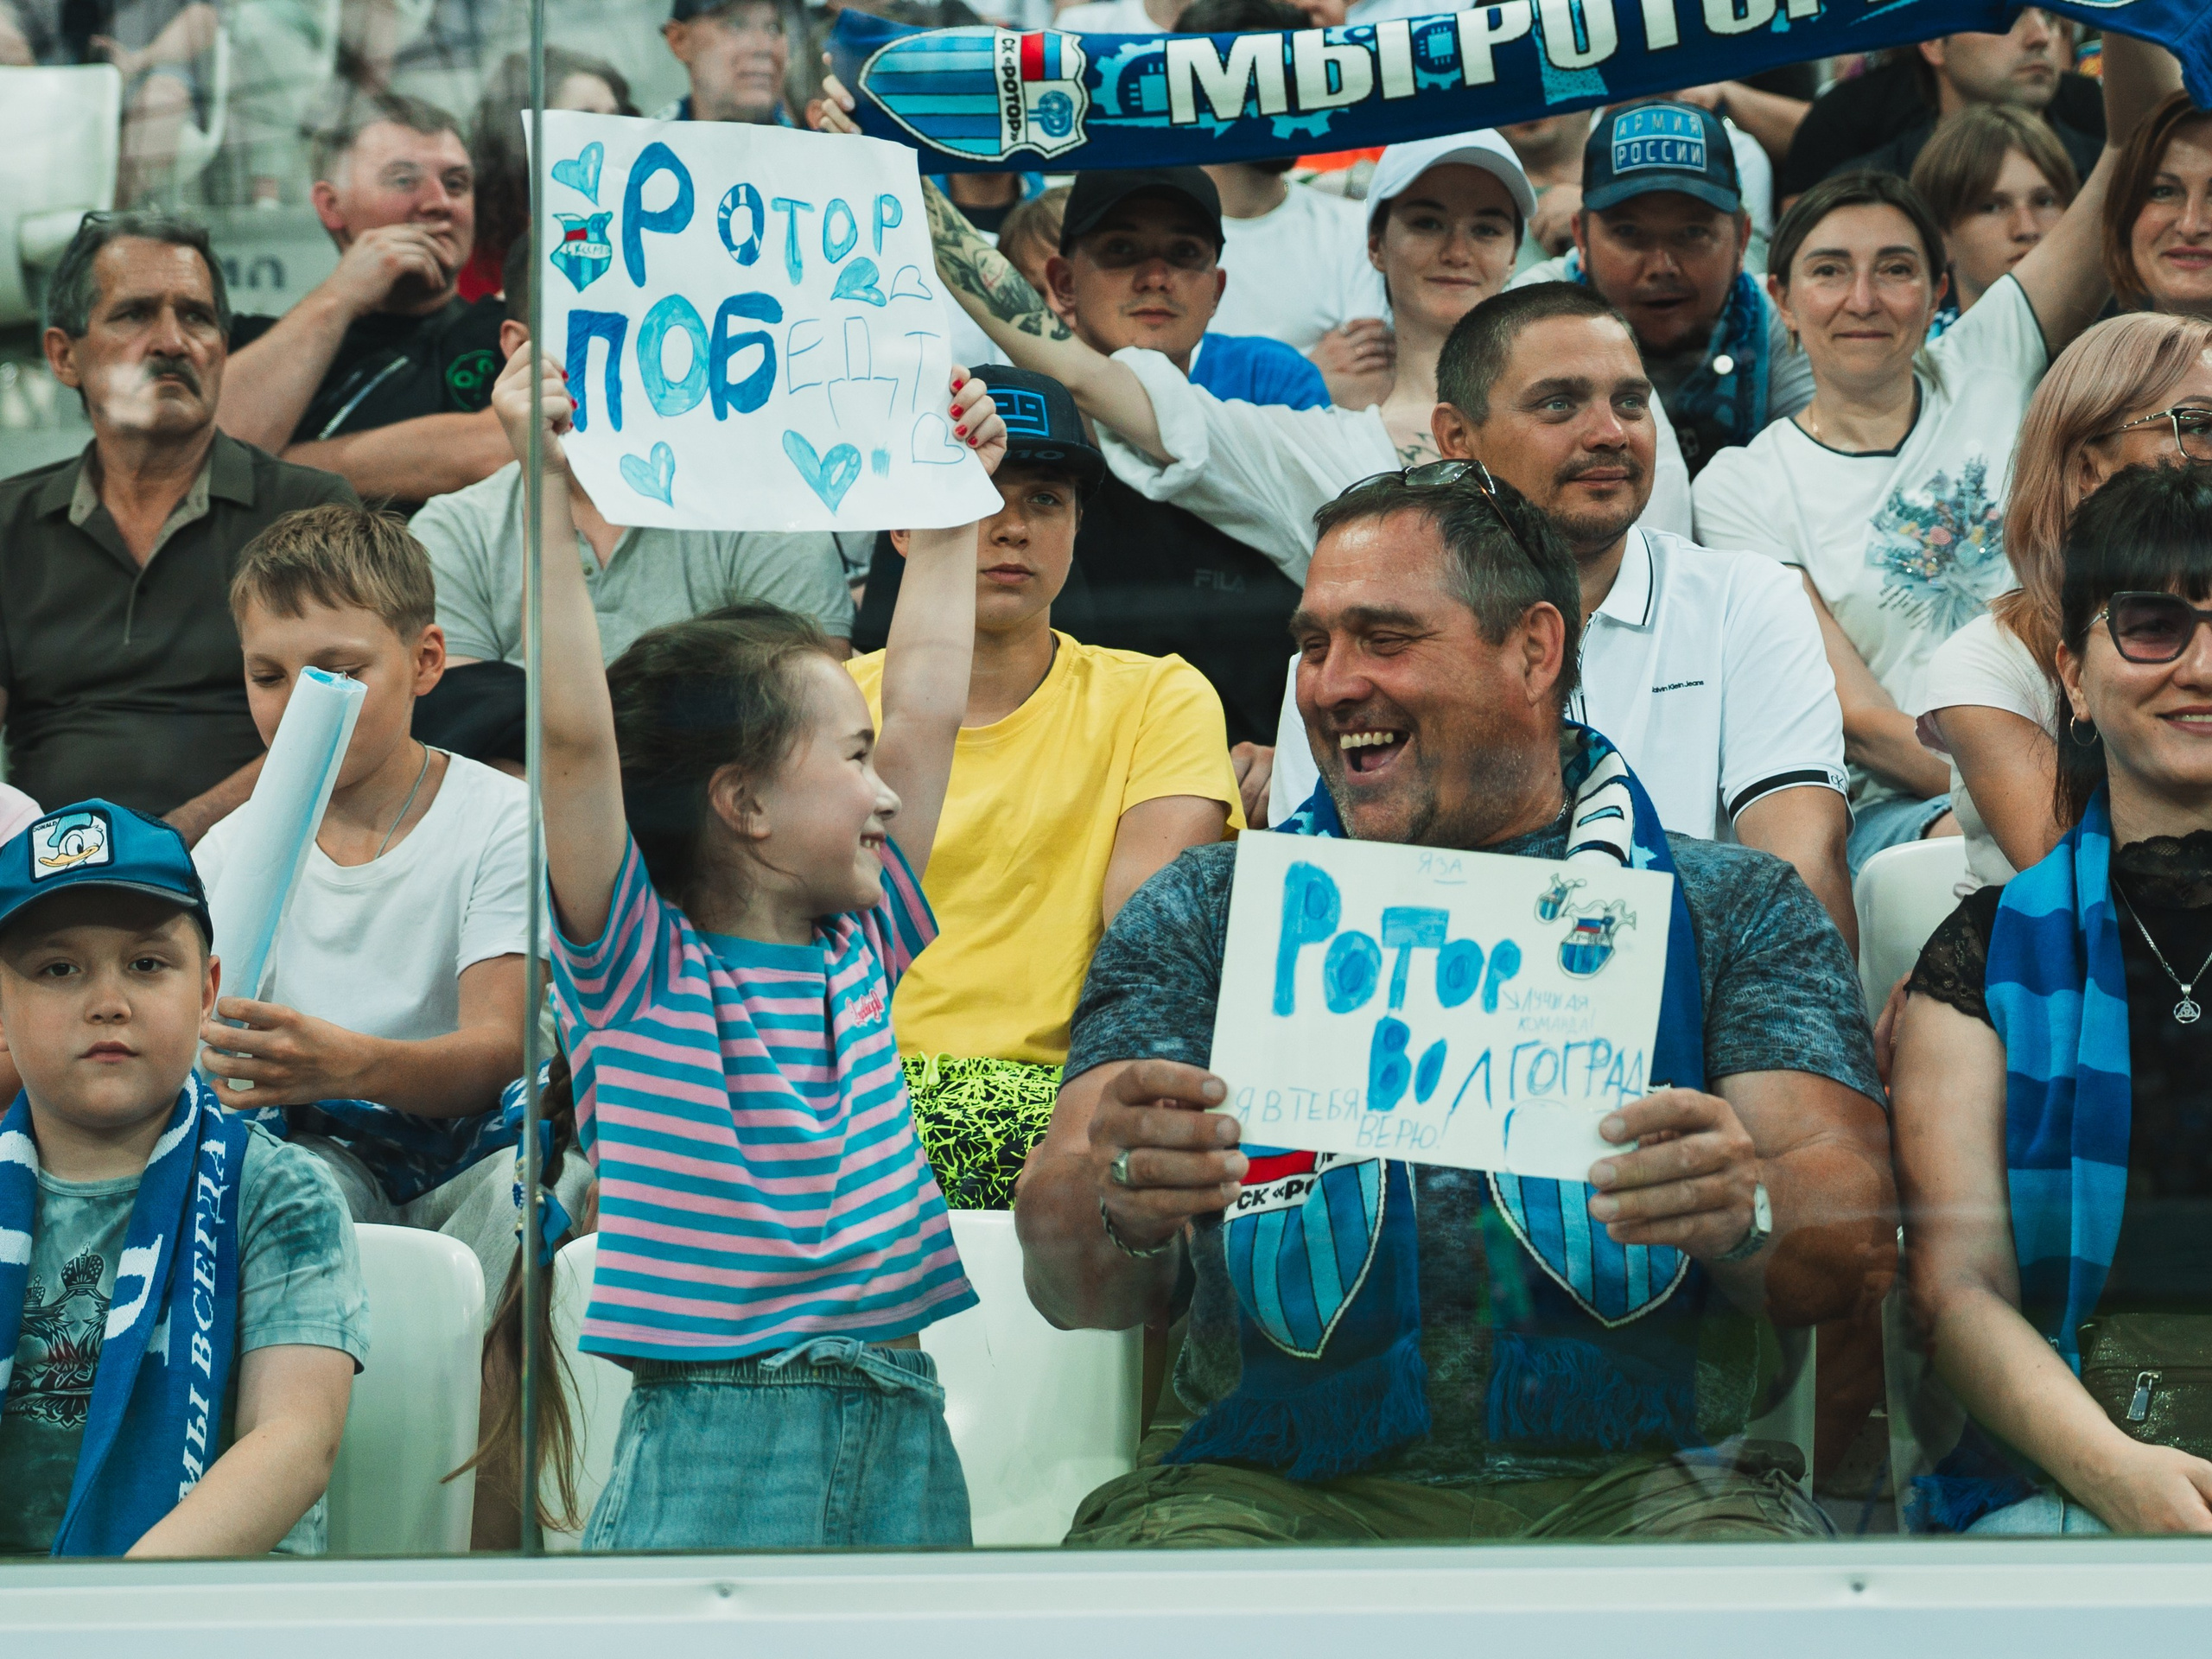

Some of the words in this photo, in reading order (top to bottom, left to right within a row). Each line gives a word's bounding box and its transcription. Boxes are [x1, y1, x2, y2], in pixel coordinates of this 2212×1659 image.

[1001, 38, 1015, 54] СК
[1166, 19, 1415, 126] МЫ
[1456, 0, 1821, 87] РОТ
[1001, 56, 1022, 142] «РОТОР»
[1618, 113, 1700, 137] АРМИЯ
[1616, 140, 1702, 166] РОССИИ
[1193, 568, 1247, 594] FILA
[1236, 1086, 1255, 1124] Я
[1262, 1090, 1282, 1122] В
[1288, 1086, 1359, 1122] ТЕБЯ
[1236, 1187, 1269, 1211] СК
[191, 1139, 230, 1379] ВСЕГДА
